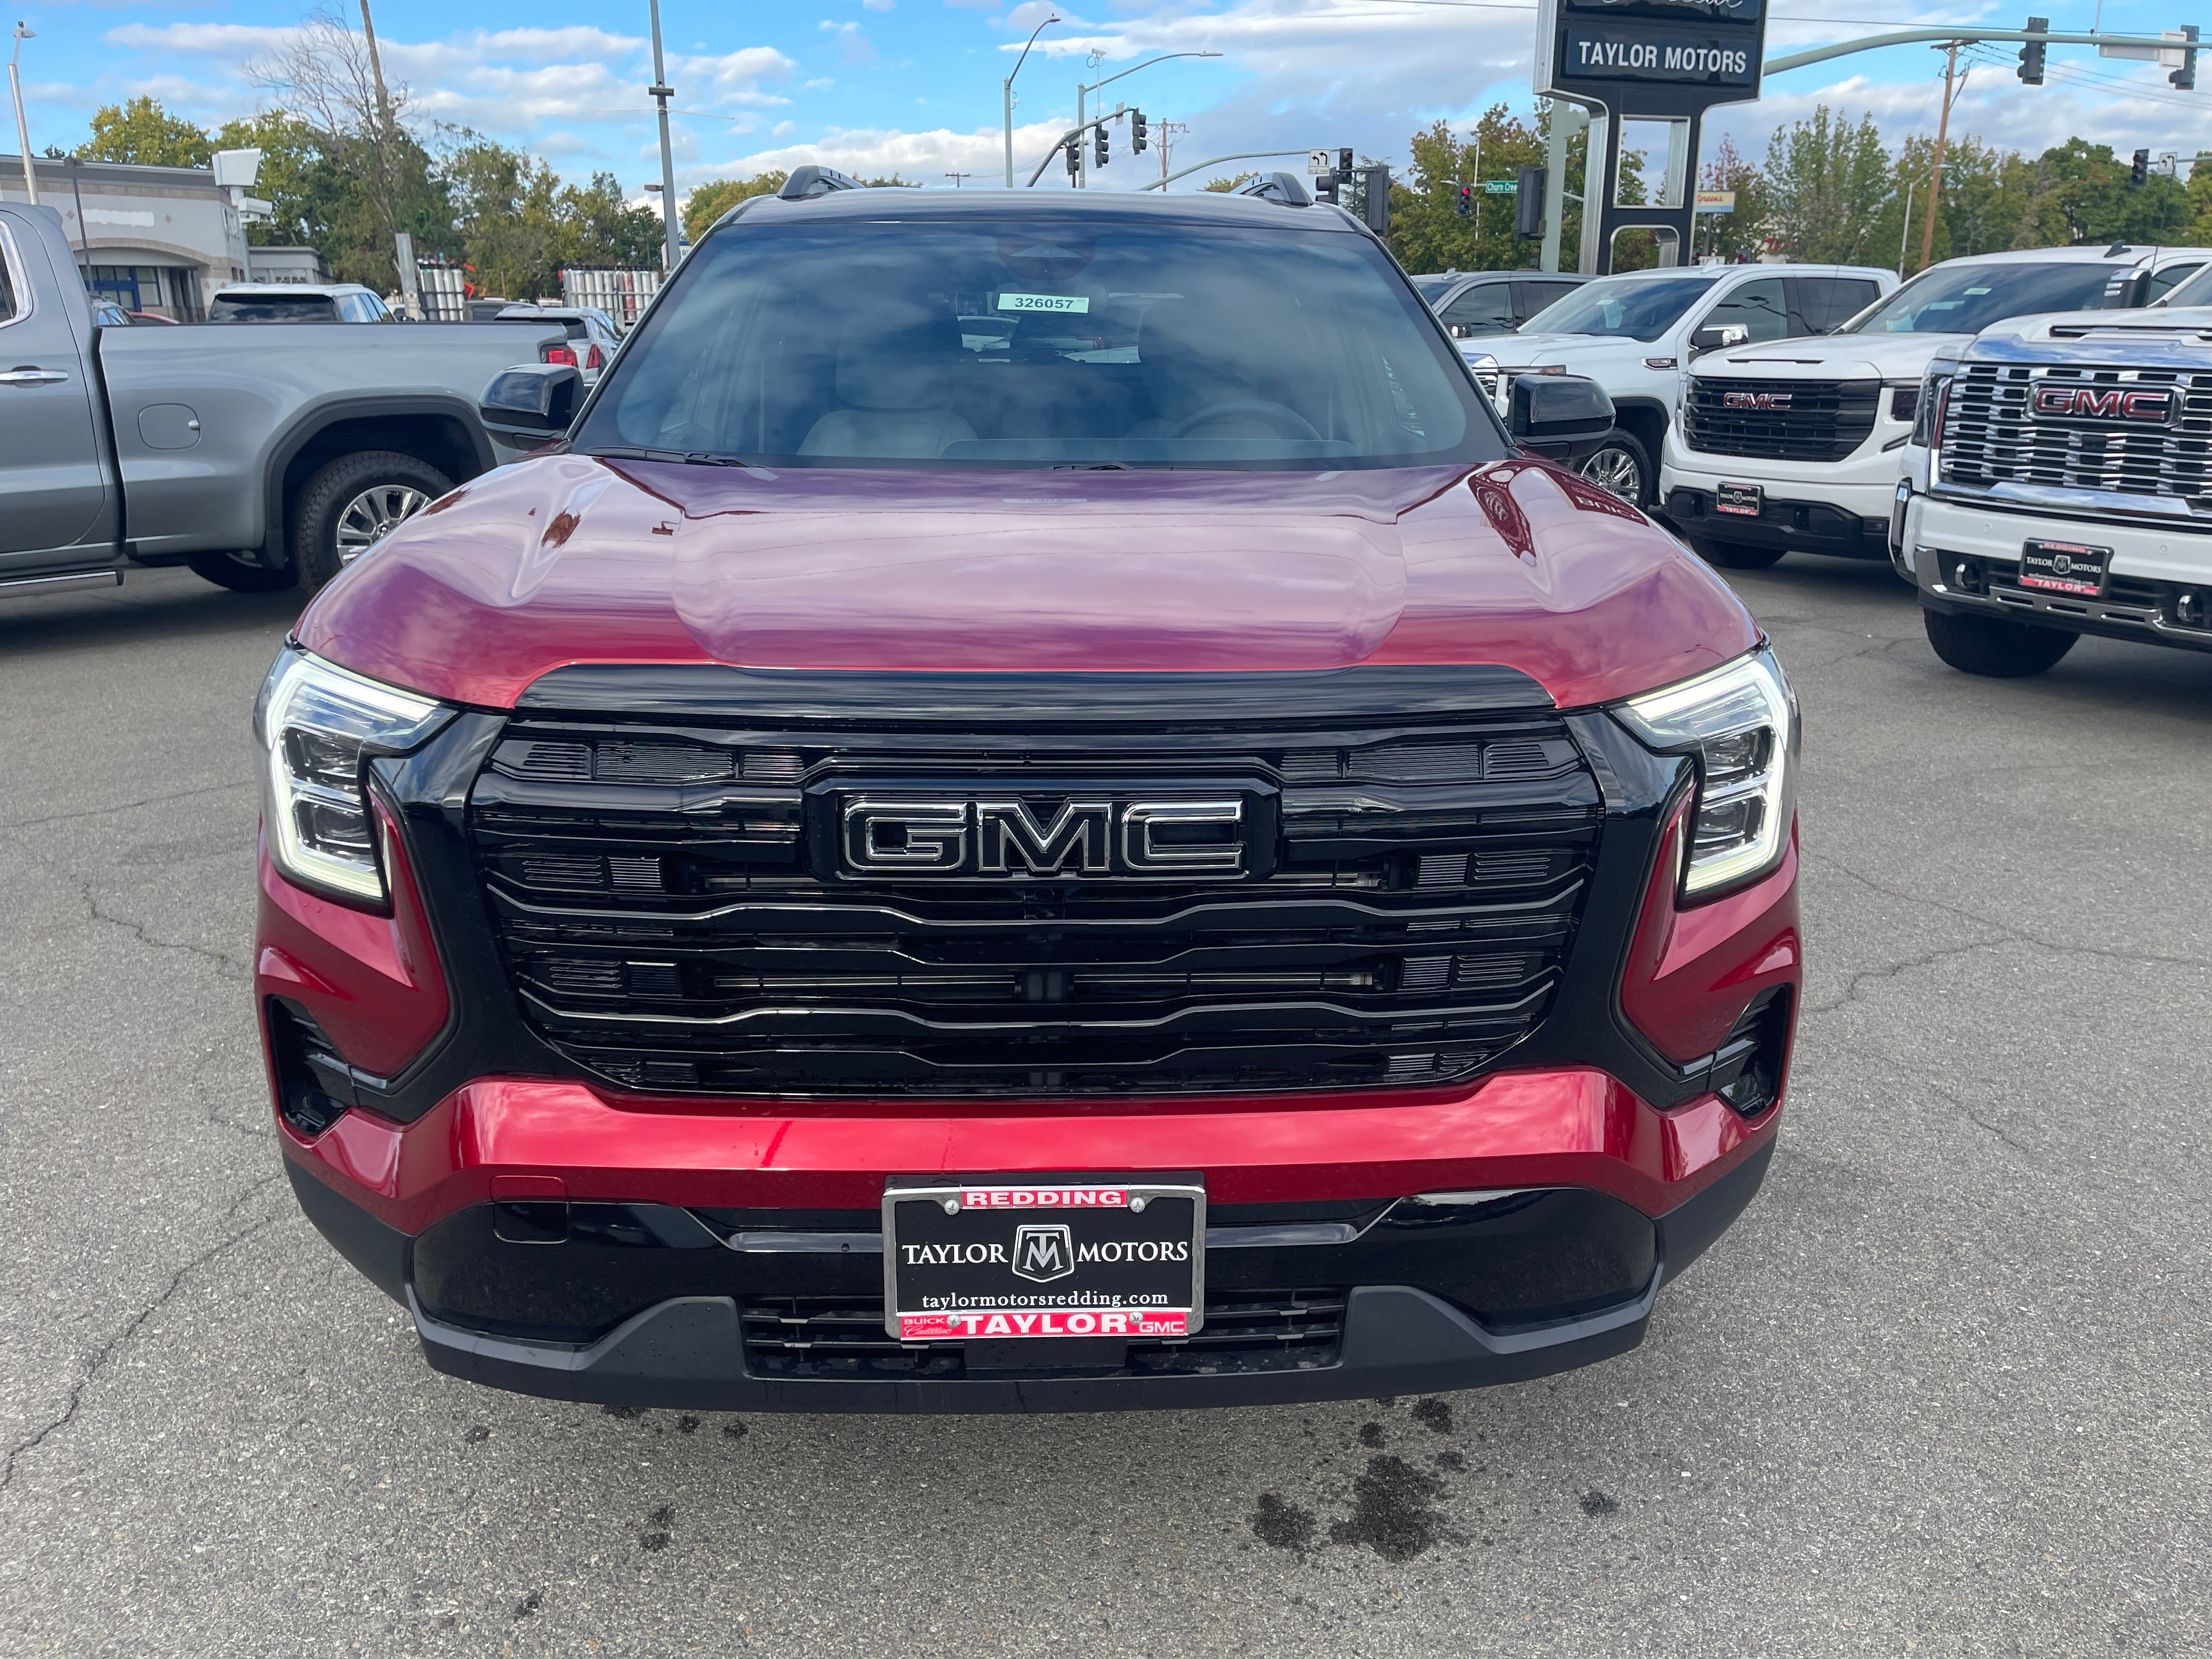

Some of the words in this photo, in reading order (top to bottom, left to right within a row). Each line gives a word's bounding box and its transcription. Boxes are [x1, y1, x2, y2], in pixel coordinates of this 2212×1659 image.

[1578, 41, 1657, 69] TAYLOR
[1664, 46, 1747, 74] MOTORS
[1487, 183, 1504, 191] Churn
[1505, 183, 1518, 191] Cree
[1015, 298, 1074, 309] 326057
[1724, 392, 1792, 410] GMC
[2035, 387, 2170, 420] GMC
[2027, 556, 2053, 567] TAYLOR
[2070, 563, 2101, 574] MOTORS
[2038, 579, 2082, 592] TAYLOR
[843, 800, 1244, 872] GMC
[966, 1191, 1123, 1205] REDDING
[901, 1243, 1009, 1265] TAYLOR
[1076, 1240, 1188, 1262] MOTORS
[922, 1290, 1168, 1310] taylormotorsredding.com
[904, 1325, 952, 1337] Cadillac
[961, 1314, 1127, 1335] TAYLOR
[1139, 1322, 1184, 1333] GMC
